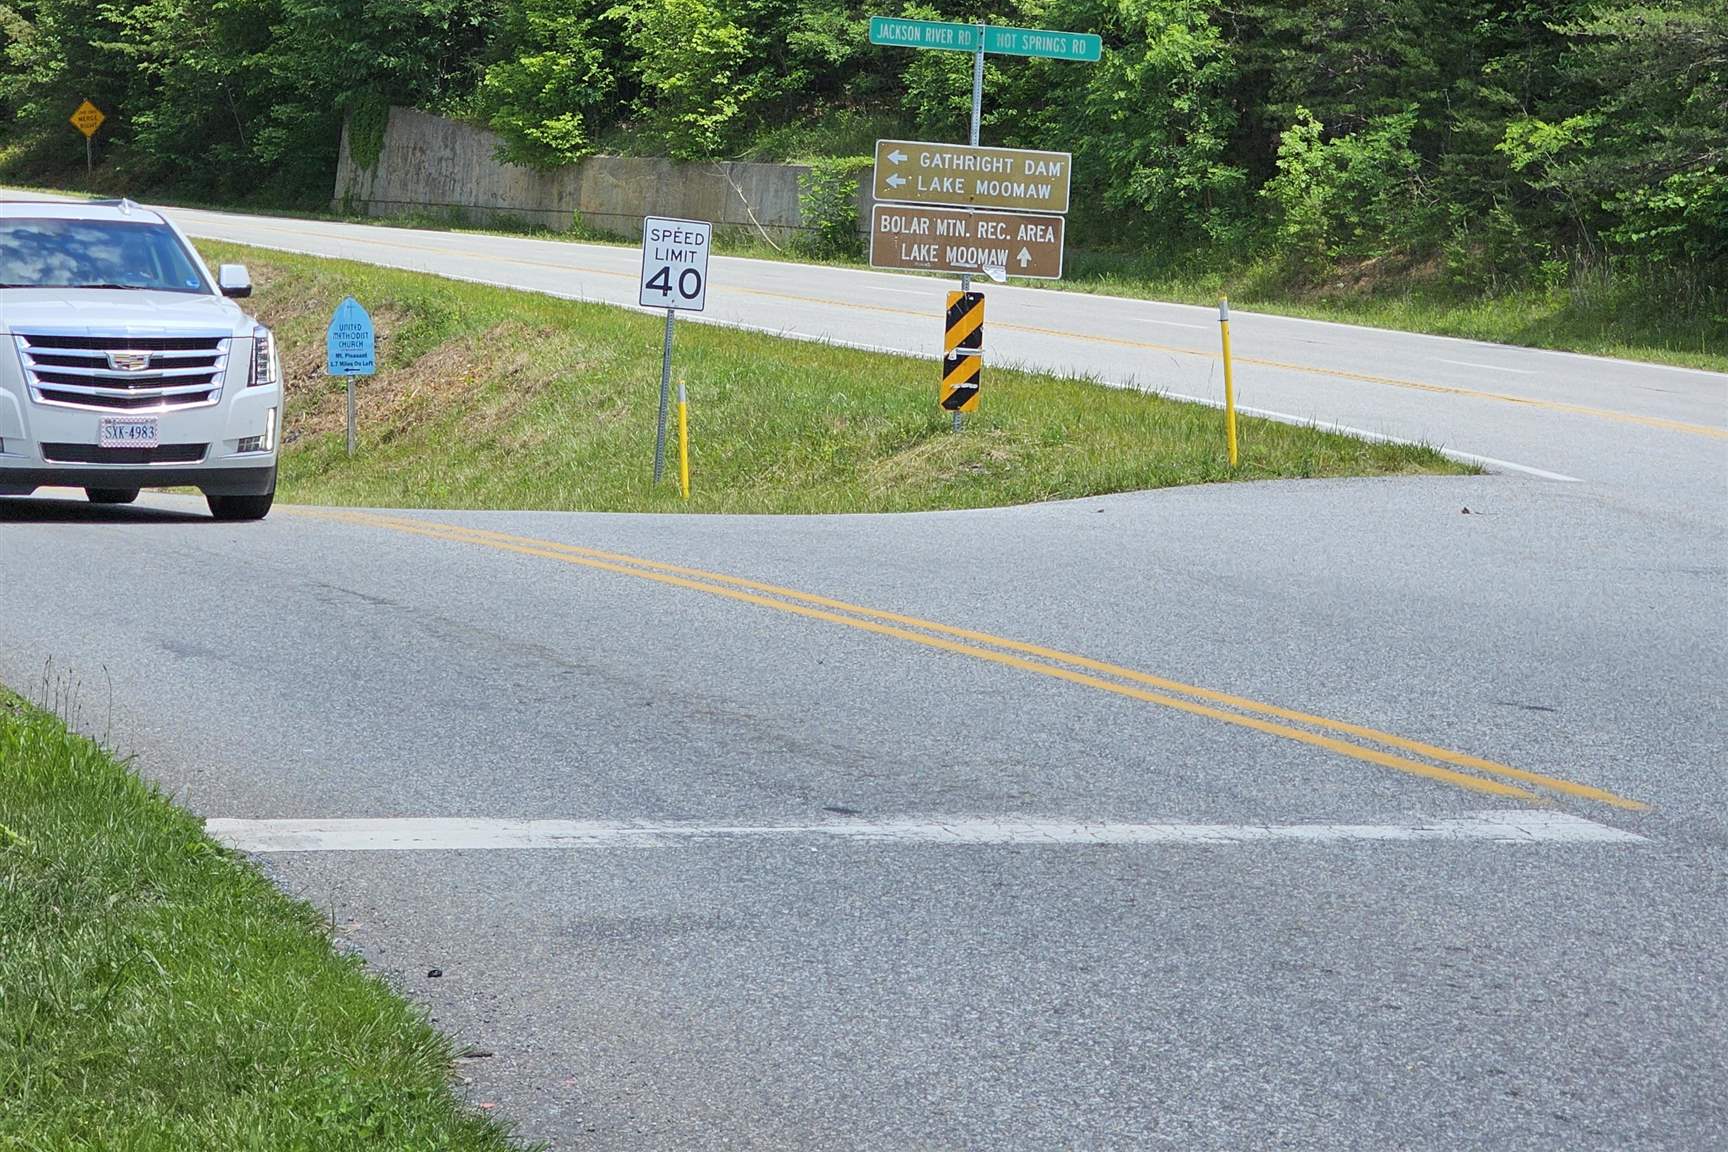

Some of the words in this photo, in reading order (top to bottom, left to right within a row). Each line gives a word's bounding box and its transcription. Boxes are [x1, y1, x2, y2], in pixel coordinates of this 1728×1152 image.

[876, 23, 921, 42] JACKSON
[925, 27, 953, 45] RIVER
[957, 30, 972, 46] RD
[996, 33, 1017, 49] HOT
[1022, 35, 1067, 53] SPRINGS
[1072, 39, 1087, 54] RD
[920, 152, 1014, 174] GATHRIGHT
[1024, 160, 1062, 177] DAM
[918, 176, 965, 194] LAKE
[976, 180, 1052, 199] MOOMAW
[650, 228, 705, 246] SPEED
[880, 215, 930, 235] BOLAR
[936, 218, 971, 238] MTN.
[977, 221, 1011, 240] REC.
[1017, 224, 1055, 243] AREA
[655, 247, 698, 263] LIMIT
[901, 243, 939, 262] LAKE
[945, 246, 1009, 266] MOOMAW
[645, 266, 702, 300] 40
[338, 340, 364, 348] CHURCH
